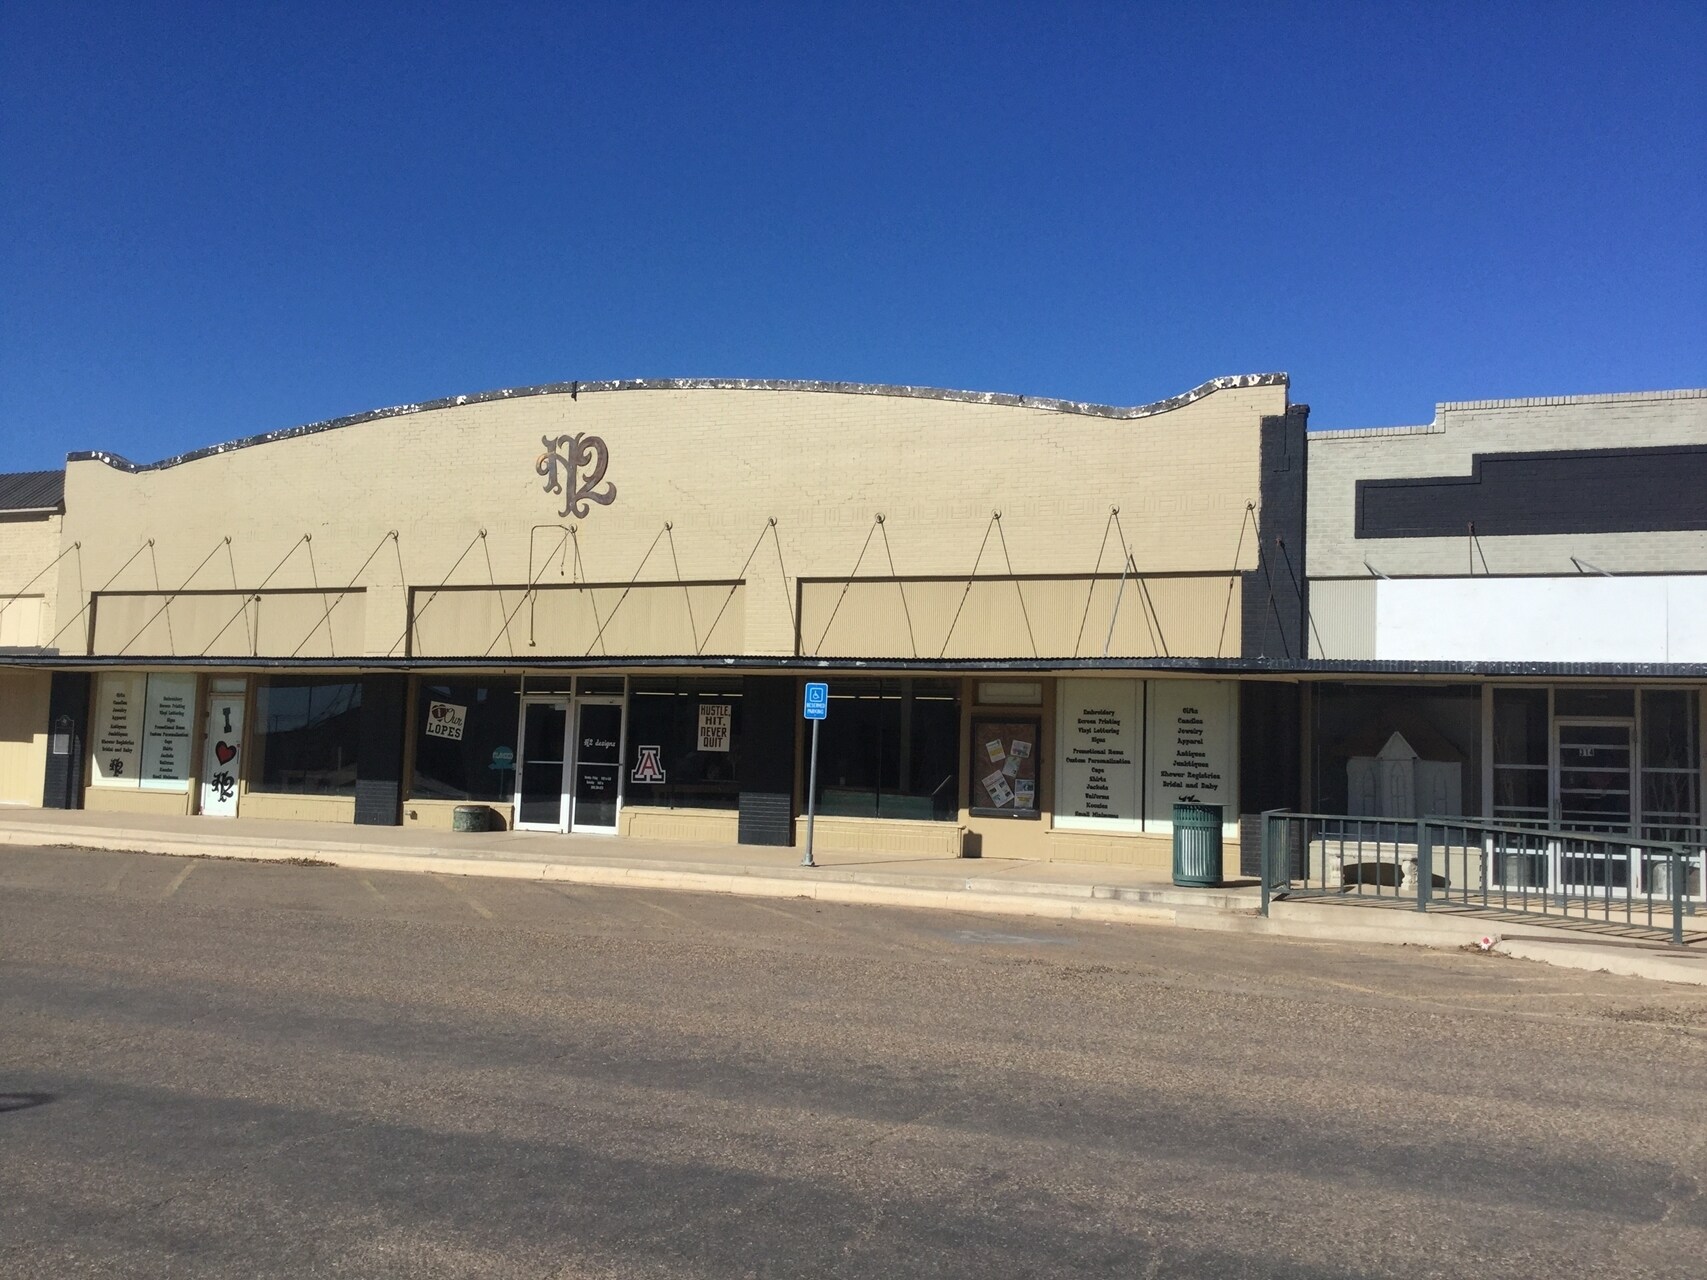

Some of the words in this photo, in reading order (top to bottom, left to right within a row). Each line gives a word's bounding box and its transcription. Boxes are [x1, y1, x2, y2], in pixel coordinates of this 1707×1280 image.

[700, 705, 731, 717] HUSTLE.
[223, 707, 232, 733] I
[444, 708, 463, 726] Our
[705, 716, 726, 726] HIT.
[1098, 718, 1120, 726] Printing
[427, 722, 461, 738] LOPES
[700, 726, 727, 738] NEVER
[1177, 728, 1203, 736] Jewelry
[594, 738, 616, 749] designs
[703, 737, 724, 748] QUIT
[1176, 750, 1205, 758] Antiques
[631, 745, 666, 784] A
[1173, 760, 1209, 768] Junktiques
[1187, 772, 1220, 780] Registries
[1201, 782, 1218, 791] Baby
